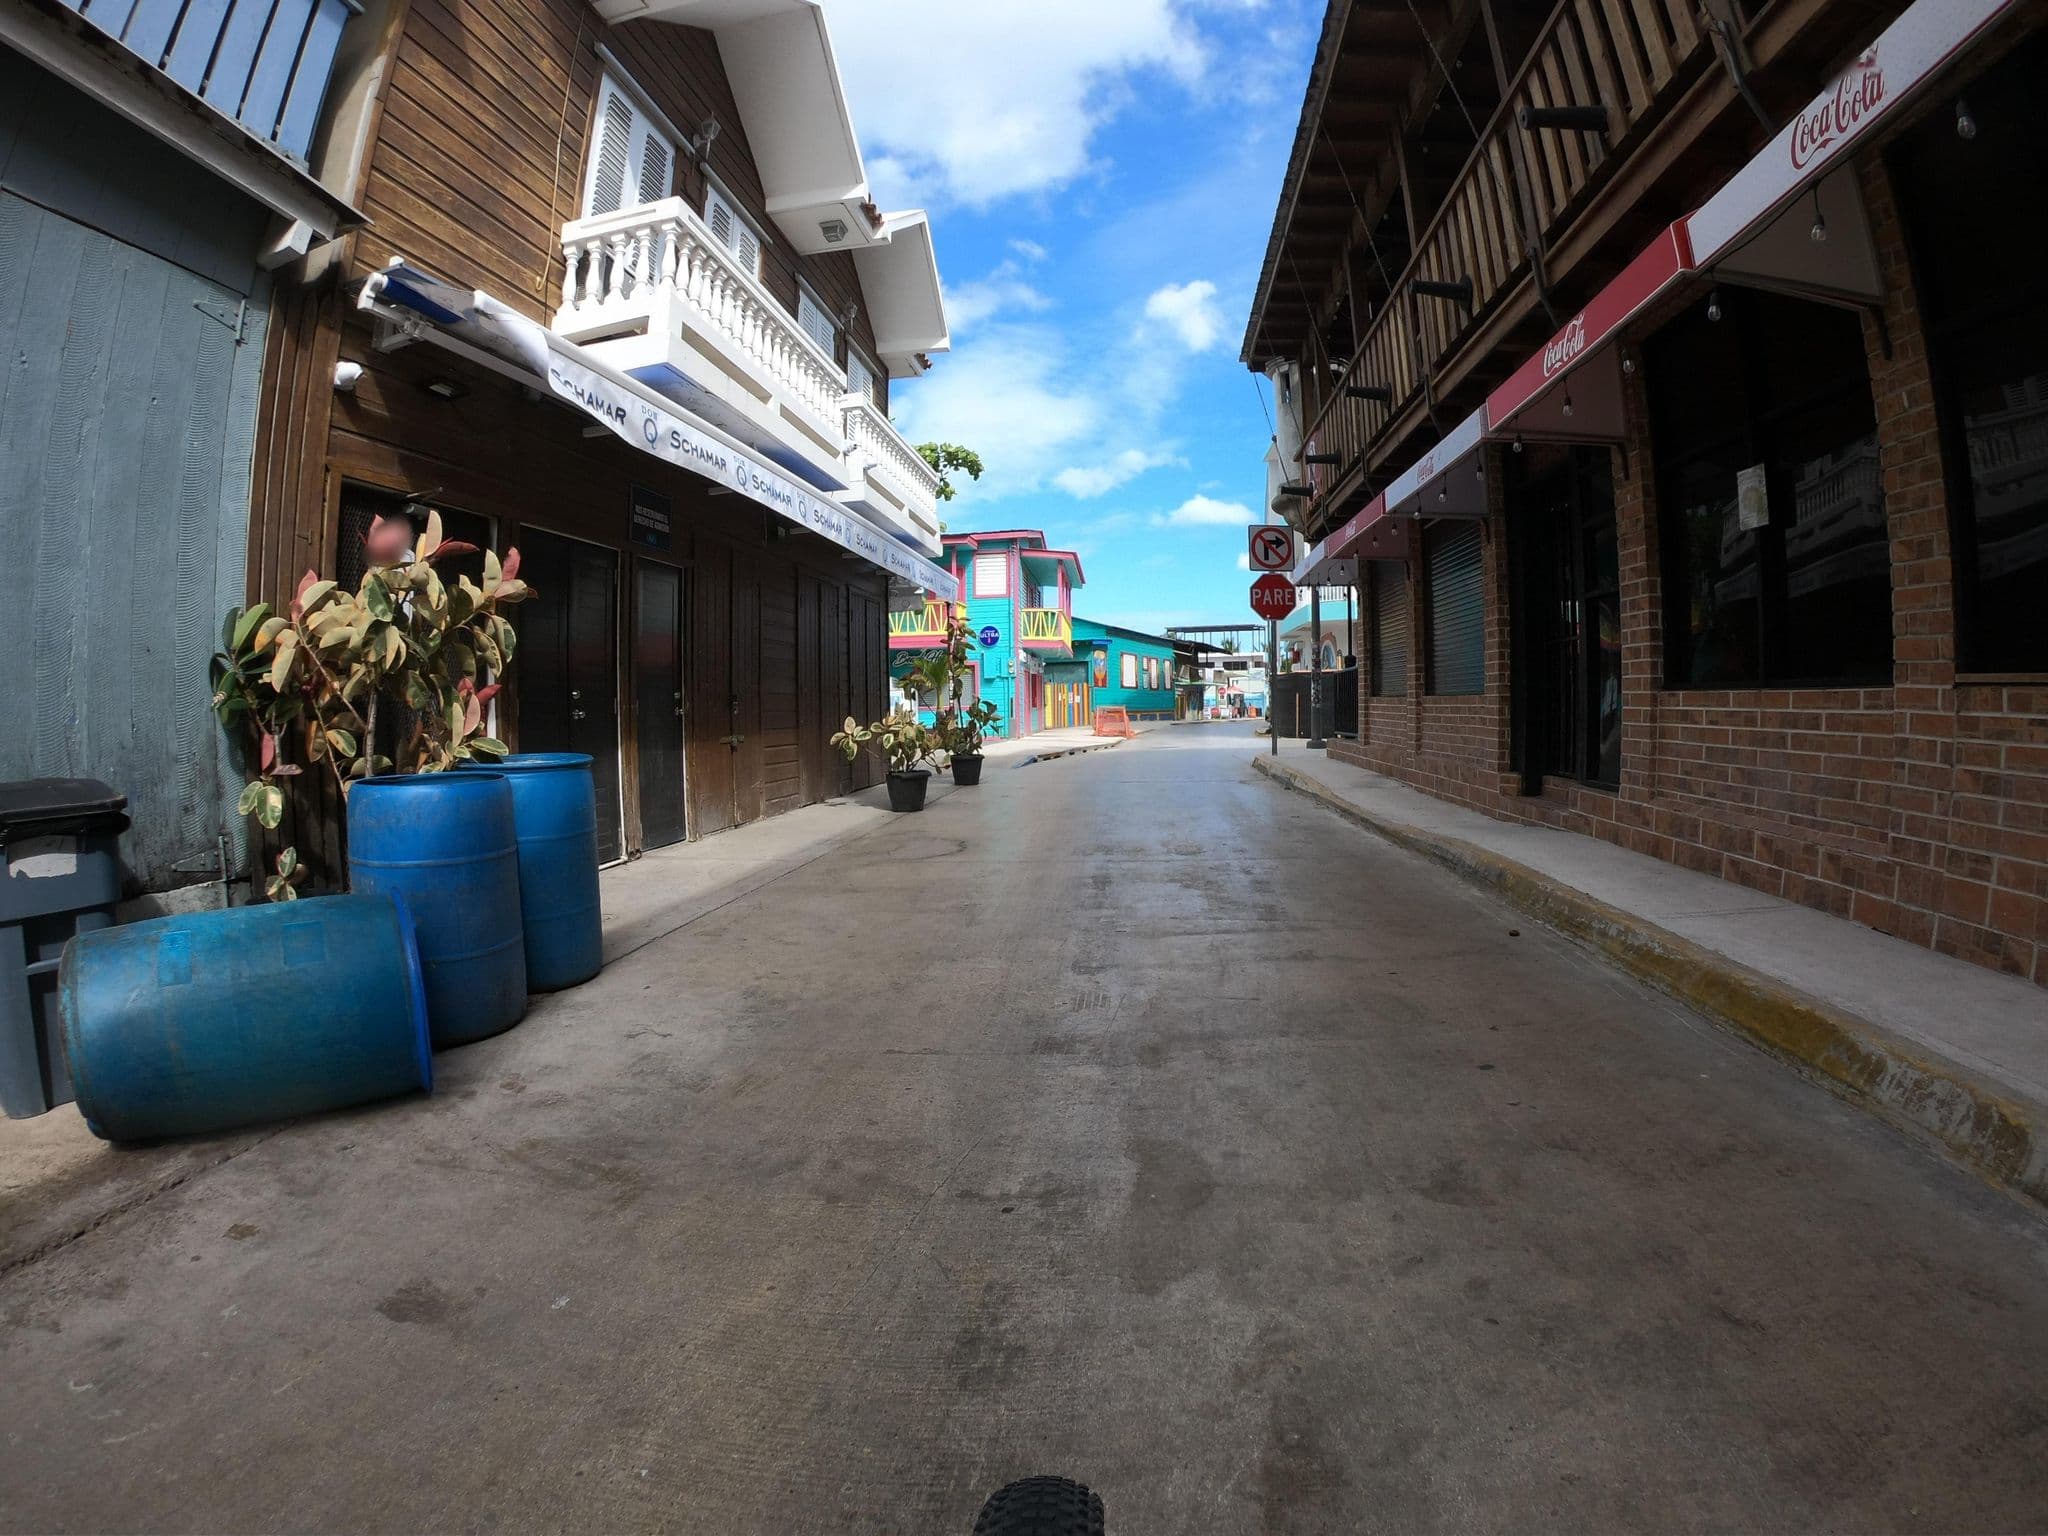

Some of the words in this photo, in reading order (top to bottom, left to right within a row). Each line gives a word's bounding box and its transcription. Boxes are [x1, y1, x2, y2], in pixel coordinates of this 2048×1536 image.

[1791, 42, 1885, 170] Coca-Cola
[643, 418, 658, 450] Q
[670, 430, 727, 473] SCHAMAR
[736, 465, 748, 492] Q
[751, 474, 792, 508] SCHAMAR
[1252, 588, 1294, 606] PARE
